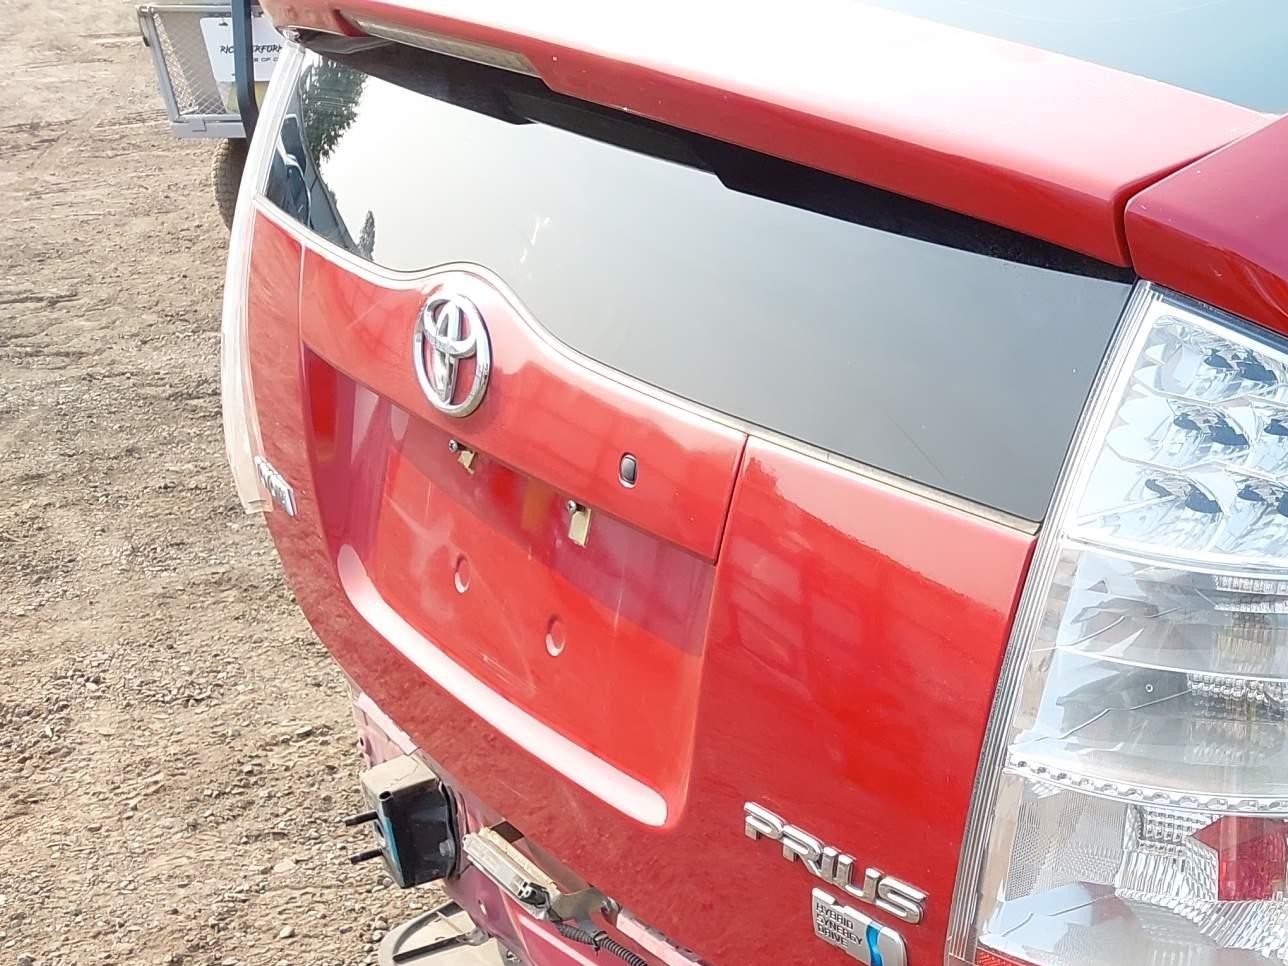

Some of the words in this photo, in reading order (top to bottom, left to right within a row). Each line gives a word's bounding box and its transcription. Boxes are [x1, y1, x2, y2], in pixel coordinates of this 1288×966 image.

[744, 801, 929, 924] PRIUS
[816, 902, 854, 930] HYBRID
[816, 912, 863, 945] SYNERGY
[817, 922, 849, 948] DRIVE
